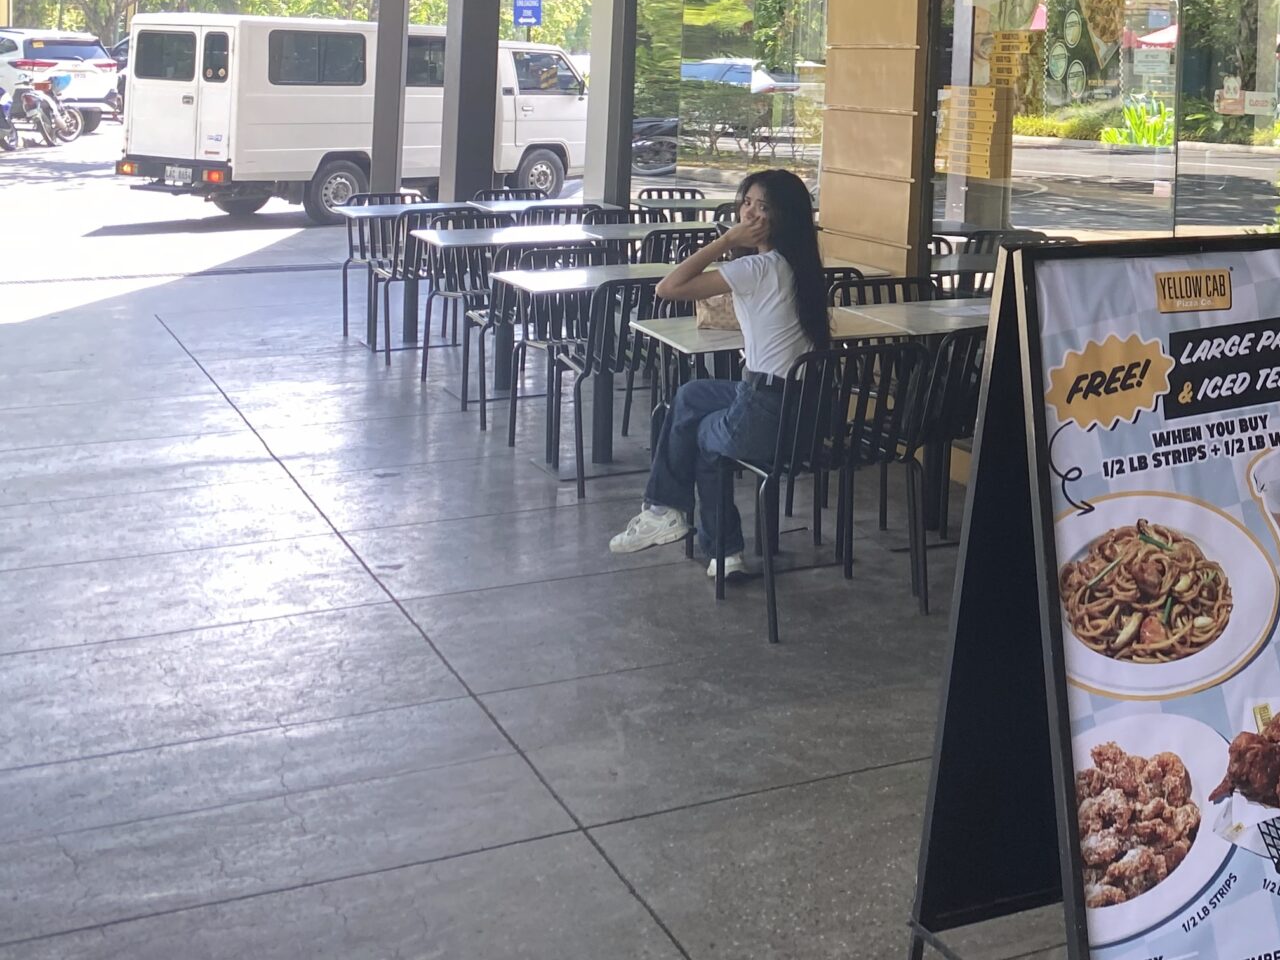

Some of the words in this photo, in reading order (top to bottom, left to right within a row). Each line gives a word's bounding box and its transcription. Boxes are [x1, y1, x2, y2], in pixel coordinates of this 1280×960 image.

[1159, 275, 1202, 300] YELLOW
[1205, 274, 1226, 297] CAB
[1177, 300, 1199, 308] Pizza
[1179, 333, 1255, 365] LARGE
[1066, 358, 1152, 405] FREE!
[1178, 381, 1194, 404] &
[1196, 371, 1251, 401] ICED
[1151, 425, 1203, 448] WHEN
[1204, 419, 1236, 439] YOU
[1238, 414, 1269, 433] BUY
[1102, 459, 1126, 478] 1/2
[1129, 454, 1149, 473] LB
[1152, 444, 1207, 468] STRIPS
[1210, 445, 1221, 456] +
[1224, 438, 1246, 457] 1/2
[1248, 434, 1266, 450] LB
[1262, 878, 1276, 893] 1/2
[1181, 916, 1199, 933] 1/2
[1196, 905, 1210, 921] LB
[1208, 872, 1238, 910] STRIPS
